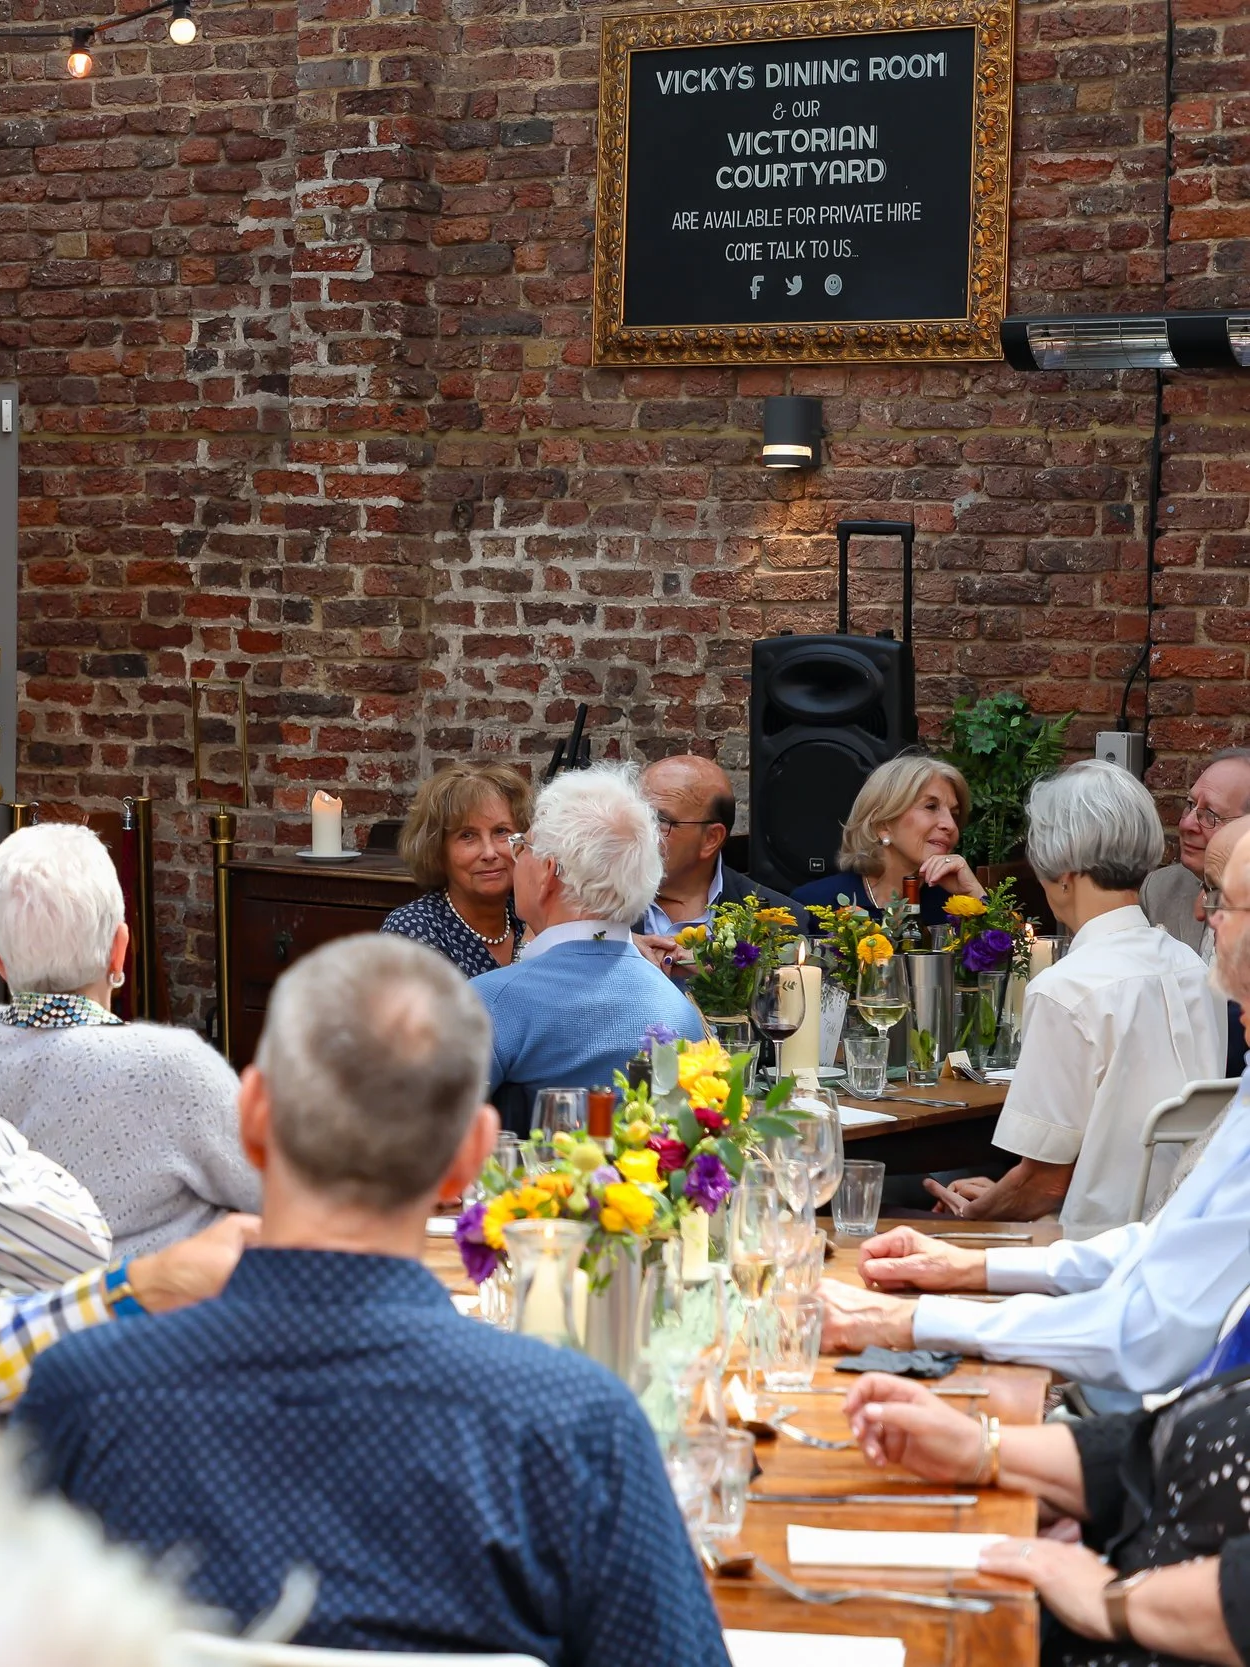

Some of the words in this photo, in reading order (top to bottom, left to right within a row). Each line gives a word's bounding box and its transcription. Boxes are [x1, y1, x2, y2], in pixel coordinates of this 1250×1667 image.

[765, 59, 860, 88] DINING
[869, 52, 947, 82] ROOM
[772, 102, 786, 120] &
[792, 100, 821, 118] OUR
[727, 125, 877, 156] VICTORIAN
[716, 158, 887, 189] COURTYARD
[672, 211, 699, 230] ARE
[703, 208, 782, 229] AVAILABLE
[787, 206, 816, 225] FOR
[819, 203, 883, 224] PRIVATE
[887, 202, 921, 221] HIRE
[725, 242, 763, 261] COME
[767, 240, 806, 260] TALK
[810, 240, 829, 258] TO
